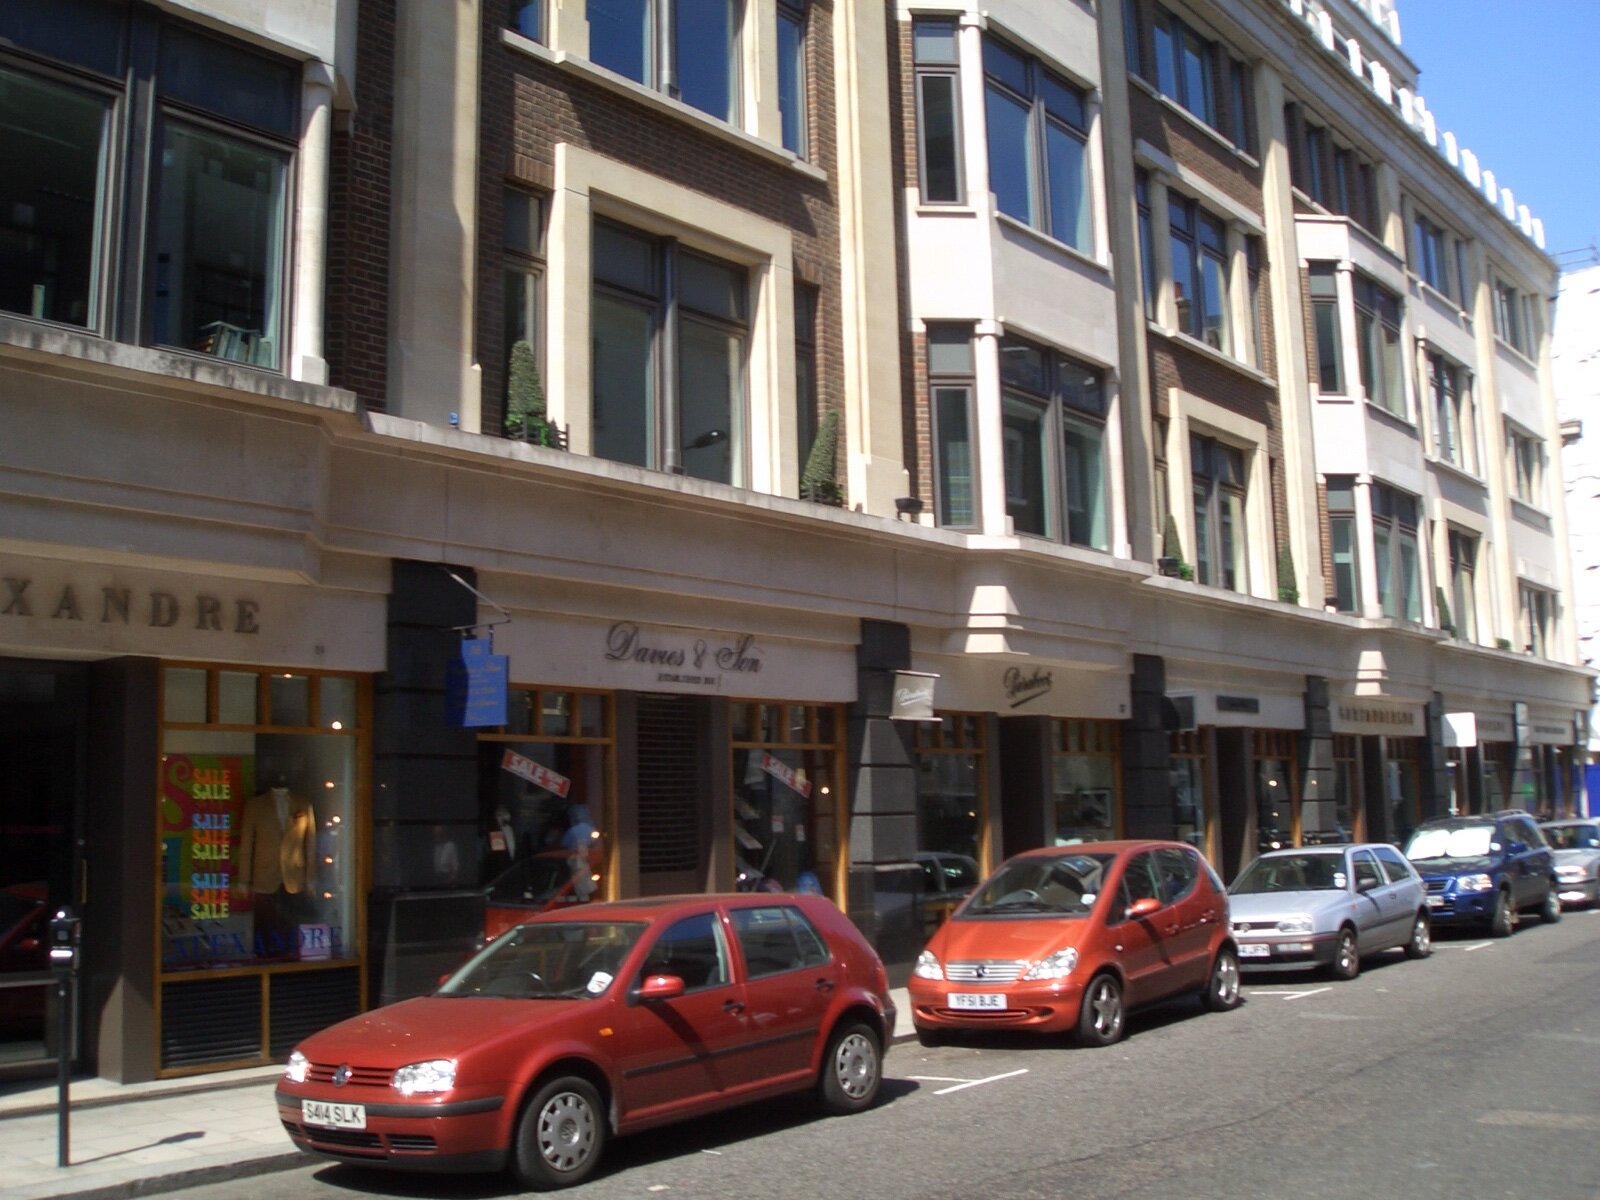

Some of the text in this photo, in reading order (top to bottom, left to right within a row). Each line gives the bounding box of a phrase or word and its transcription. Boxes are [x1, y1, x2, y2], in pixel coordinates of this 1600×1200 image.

[2, 577, 259, 634] XANDRE
[605, 620, 764, 673] Davies & Son
[192, 768, 231, 784] SALE
[511, 755, 543, 786] SALE
[192, 784, 231, 800] SALE
[192, 814, 231, 830] SALE
[192, 830, 230, 845] SALE
[192, 844, 230, 860] SALE
[191, 873, 229, 889] SALE
[191, 889, 230, 904] SALE
[191, 903, 229, 920] SALE
[955, 994, 999, 1007] YF51 BJE
[306, 1102, 361, 1124] S414 SLK
